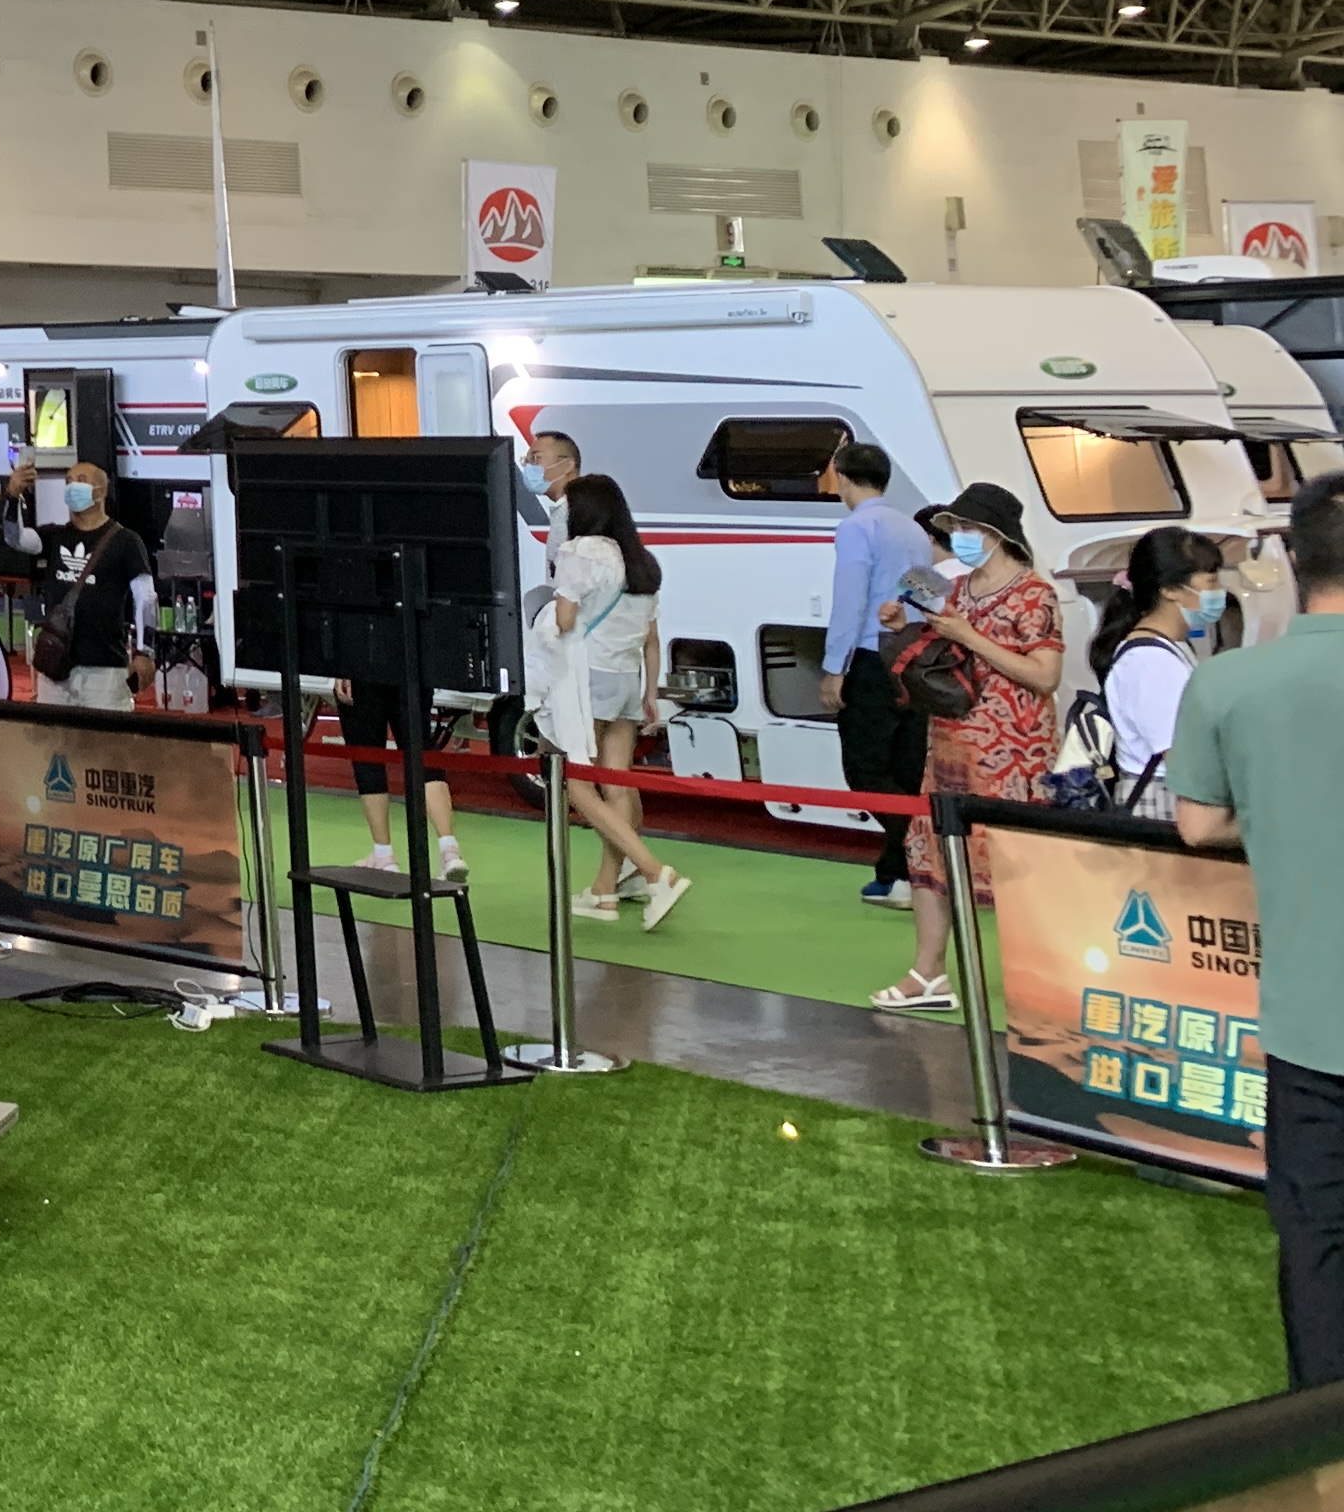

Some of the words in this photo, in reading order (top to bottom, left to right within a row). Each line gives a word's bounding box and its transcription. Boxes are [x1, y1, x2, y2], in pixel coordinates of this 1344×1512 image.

[148, 424, 175, 436] ETRV
[85, 768, 156, 799] 中国重汽
[86, 793, 156, 815] SINOTRUK
[26, 827, 181, 875] 重汽原厂房车
[25, 867, 184, 919] 进口曼恩品质
[1085, 992, 1260, 1058] 重汽原厂
[1088, 1052, 1268, 1127] 进口曼恩
